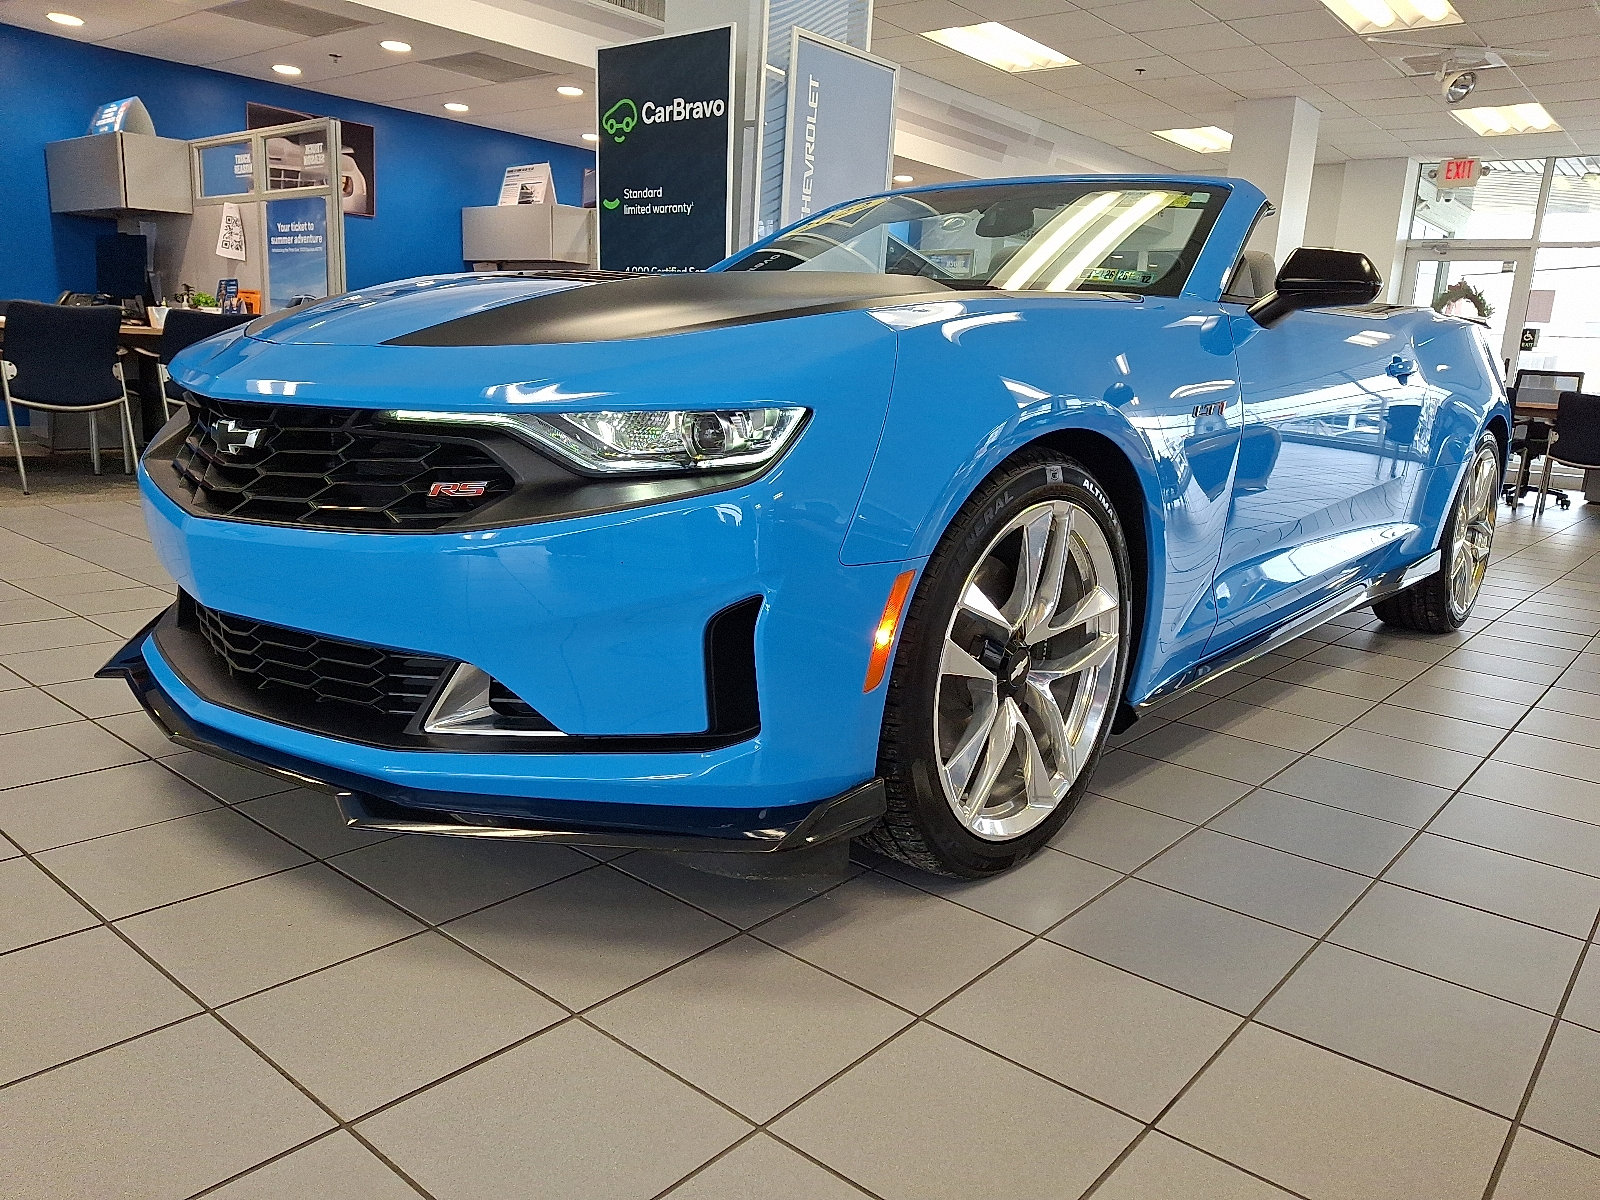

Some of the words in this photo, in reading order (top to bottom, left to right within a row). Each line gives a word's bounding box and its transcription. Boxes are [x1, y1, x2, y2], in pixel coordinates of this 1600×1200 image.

[641, 97, 725, 125] CarBravo
[801, 73, 820, 219] HEVROLET
[1445, 160, 1474, 180] EXIT
[623, 186, 663, 199] Standard
[623, 203, 652, 215] limited
[277, 222, 290, 232] Your
[290, 221, 308, 232] ticket
[307, 221, 314, 231] to
[271, 236, 293, 245] summer
[293, 233, 323, 244] adventure
[427, 481, 488, 497] RS
